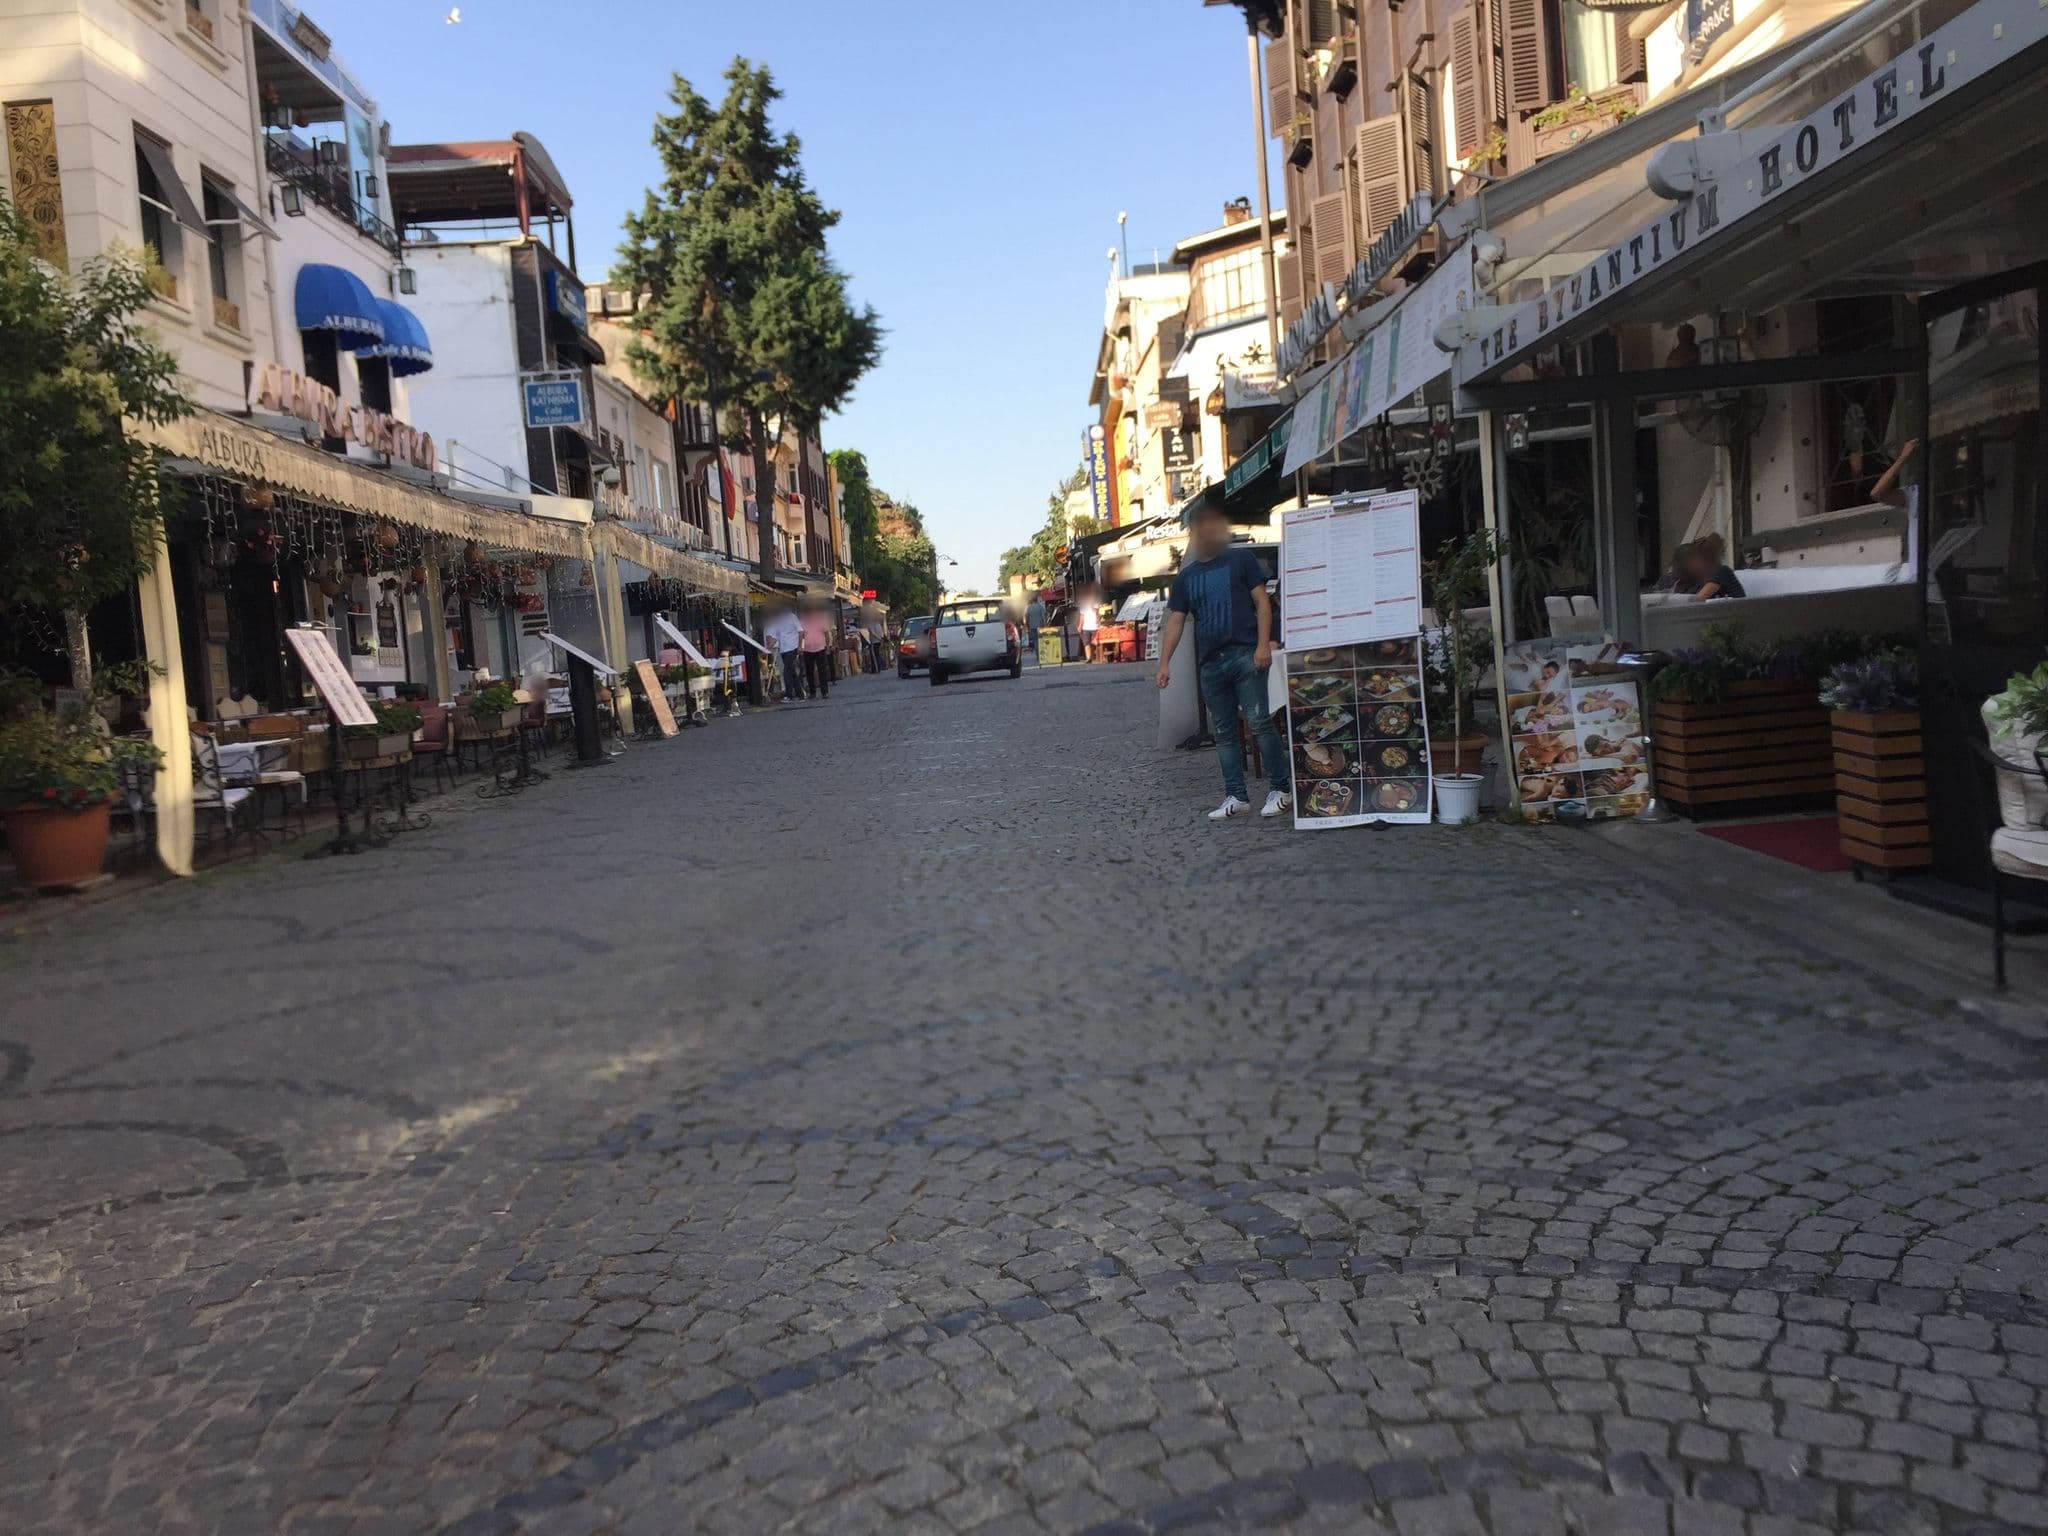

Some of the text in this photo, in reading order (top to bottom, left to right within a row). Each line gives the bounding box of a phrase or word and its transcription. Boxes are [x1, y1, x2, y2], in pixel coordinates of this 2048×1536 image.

[1537, 185, 1719, 332] BYZANTIUM
[1759, 42, 1945, 197] HOTEL
[202, 427, 266, 473] ALBURA
